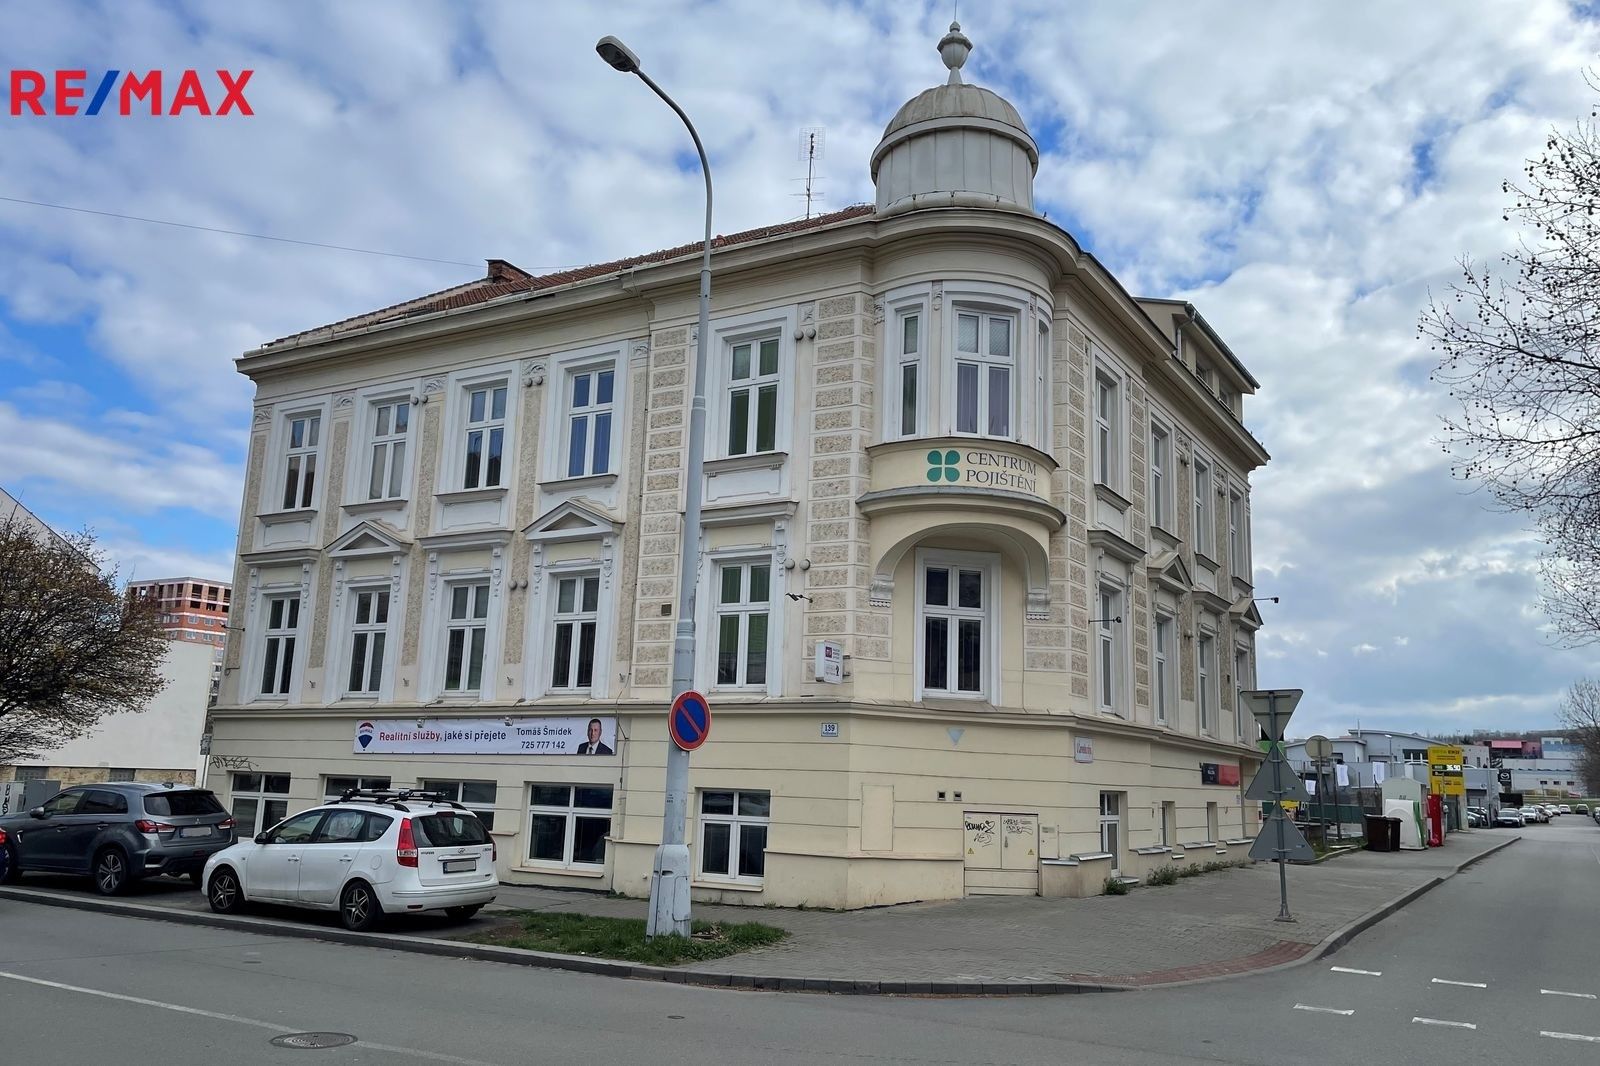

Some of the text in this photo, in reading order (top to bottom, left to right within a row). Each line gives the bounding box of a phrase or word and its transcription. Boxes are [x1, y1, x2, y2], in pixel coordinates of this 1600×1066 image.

[966, 451, 1037, 476] CENTRUM
[965, 469, 1037, 493] POJIŠTĚNÍ
[516, 725, 573, 736] Tomáš Šmídek
[824, 724, 835, 732] 139
[379, 731, 411, 741] Realitní
[412, 730, 443, 742] služby,
[444, 730, 463, 742] jaké
[464, 730, 473, 740] si
[474, 730, 507, 742] přejete
[521, 741, 566, 749] 725 777 142
